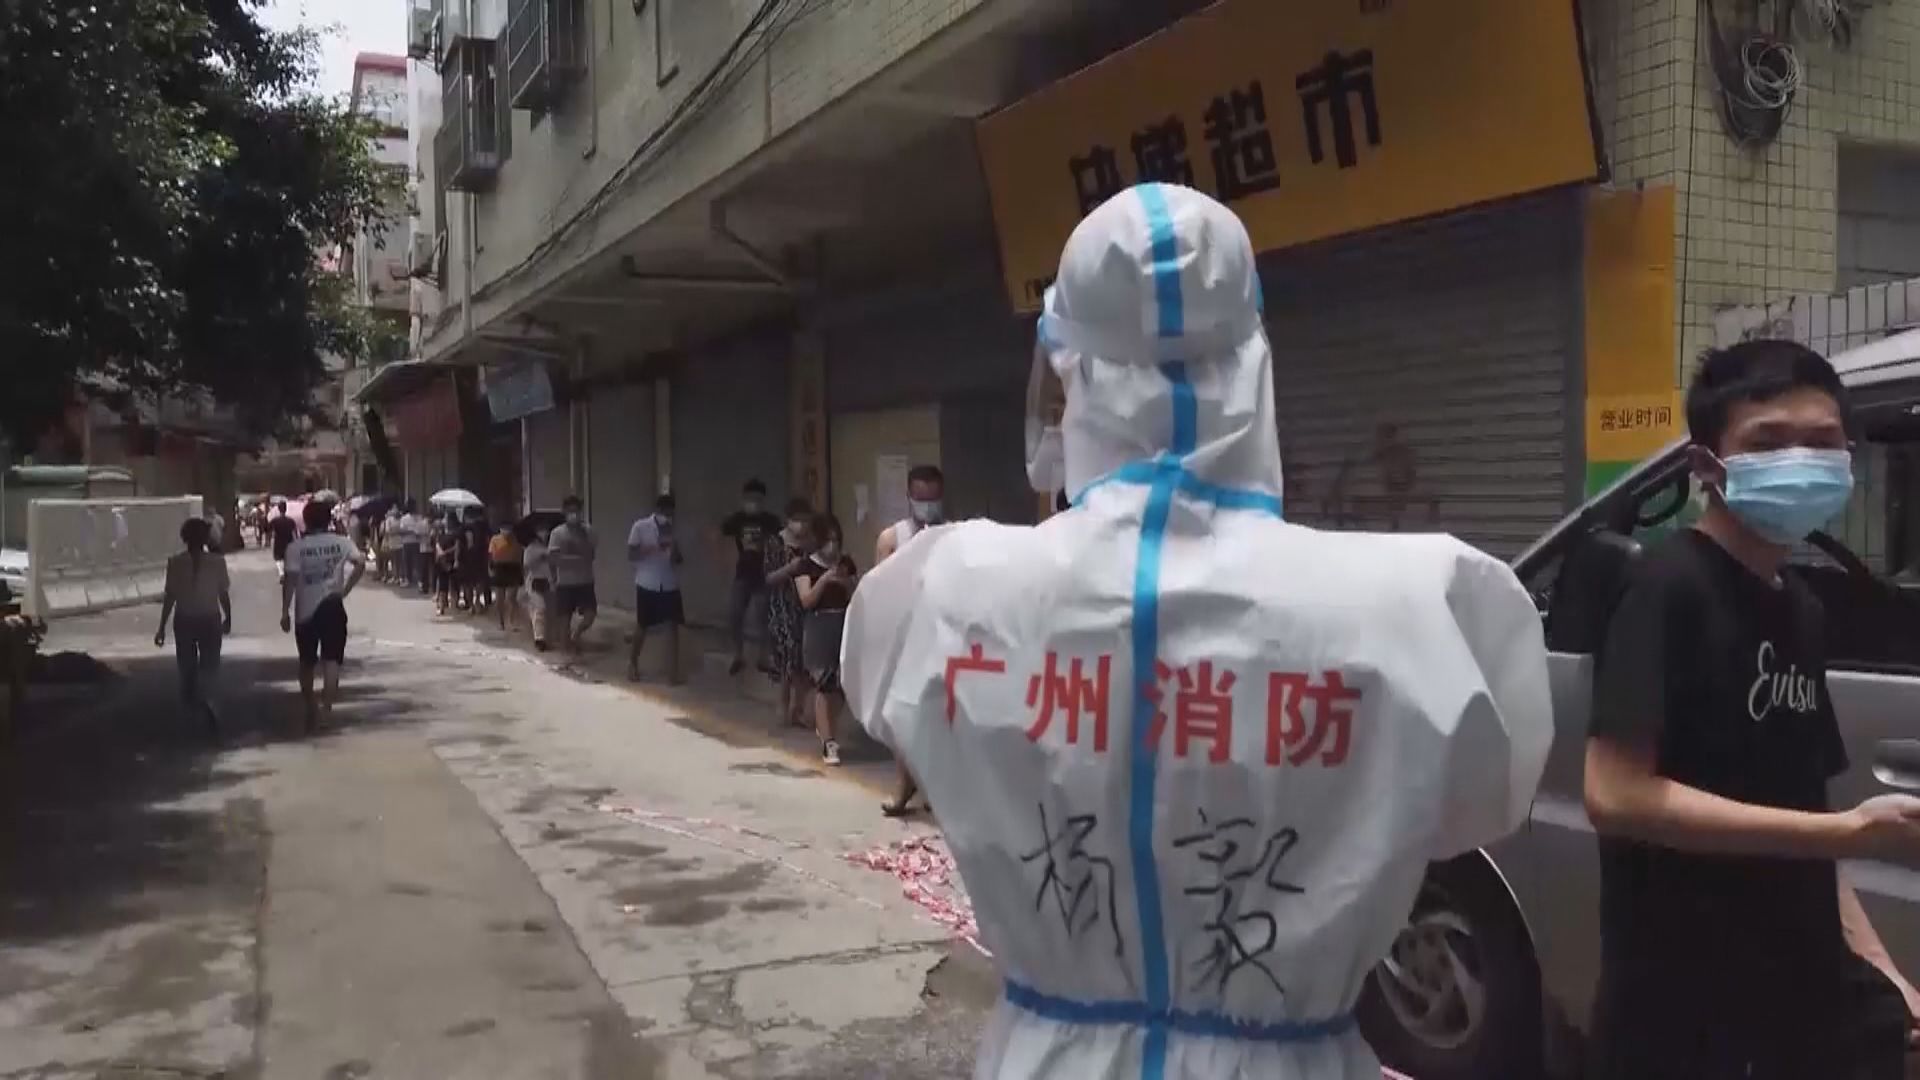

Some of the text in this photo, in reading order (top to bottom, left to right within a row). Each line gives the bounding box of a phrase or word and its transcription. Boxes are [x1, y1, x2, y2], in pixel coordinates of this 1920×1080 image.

[1600, 406, 1672, 432] 营业时间
[944, 643, 1362, 767] 广州消防
[1747, 640, 1817, 721] Evisu
